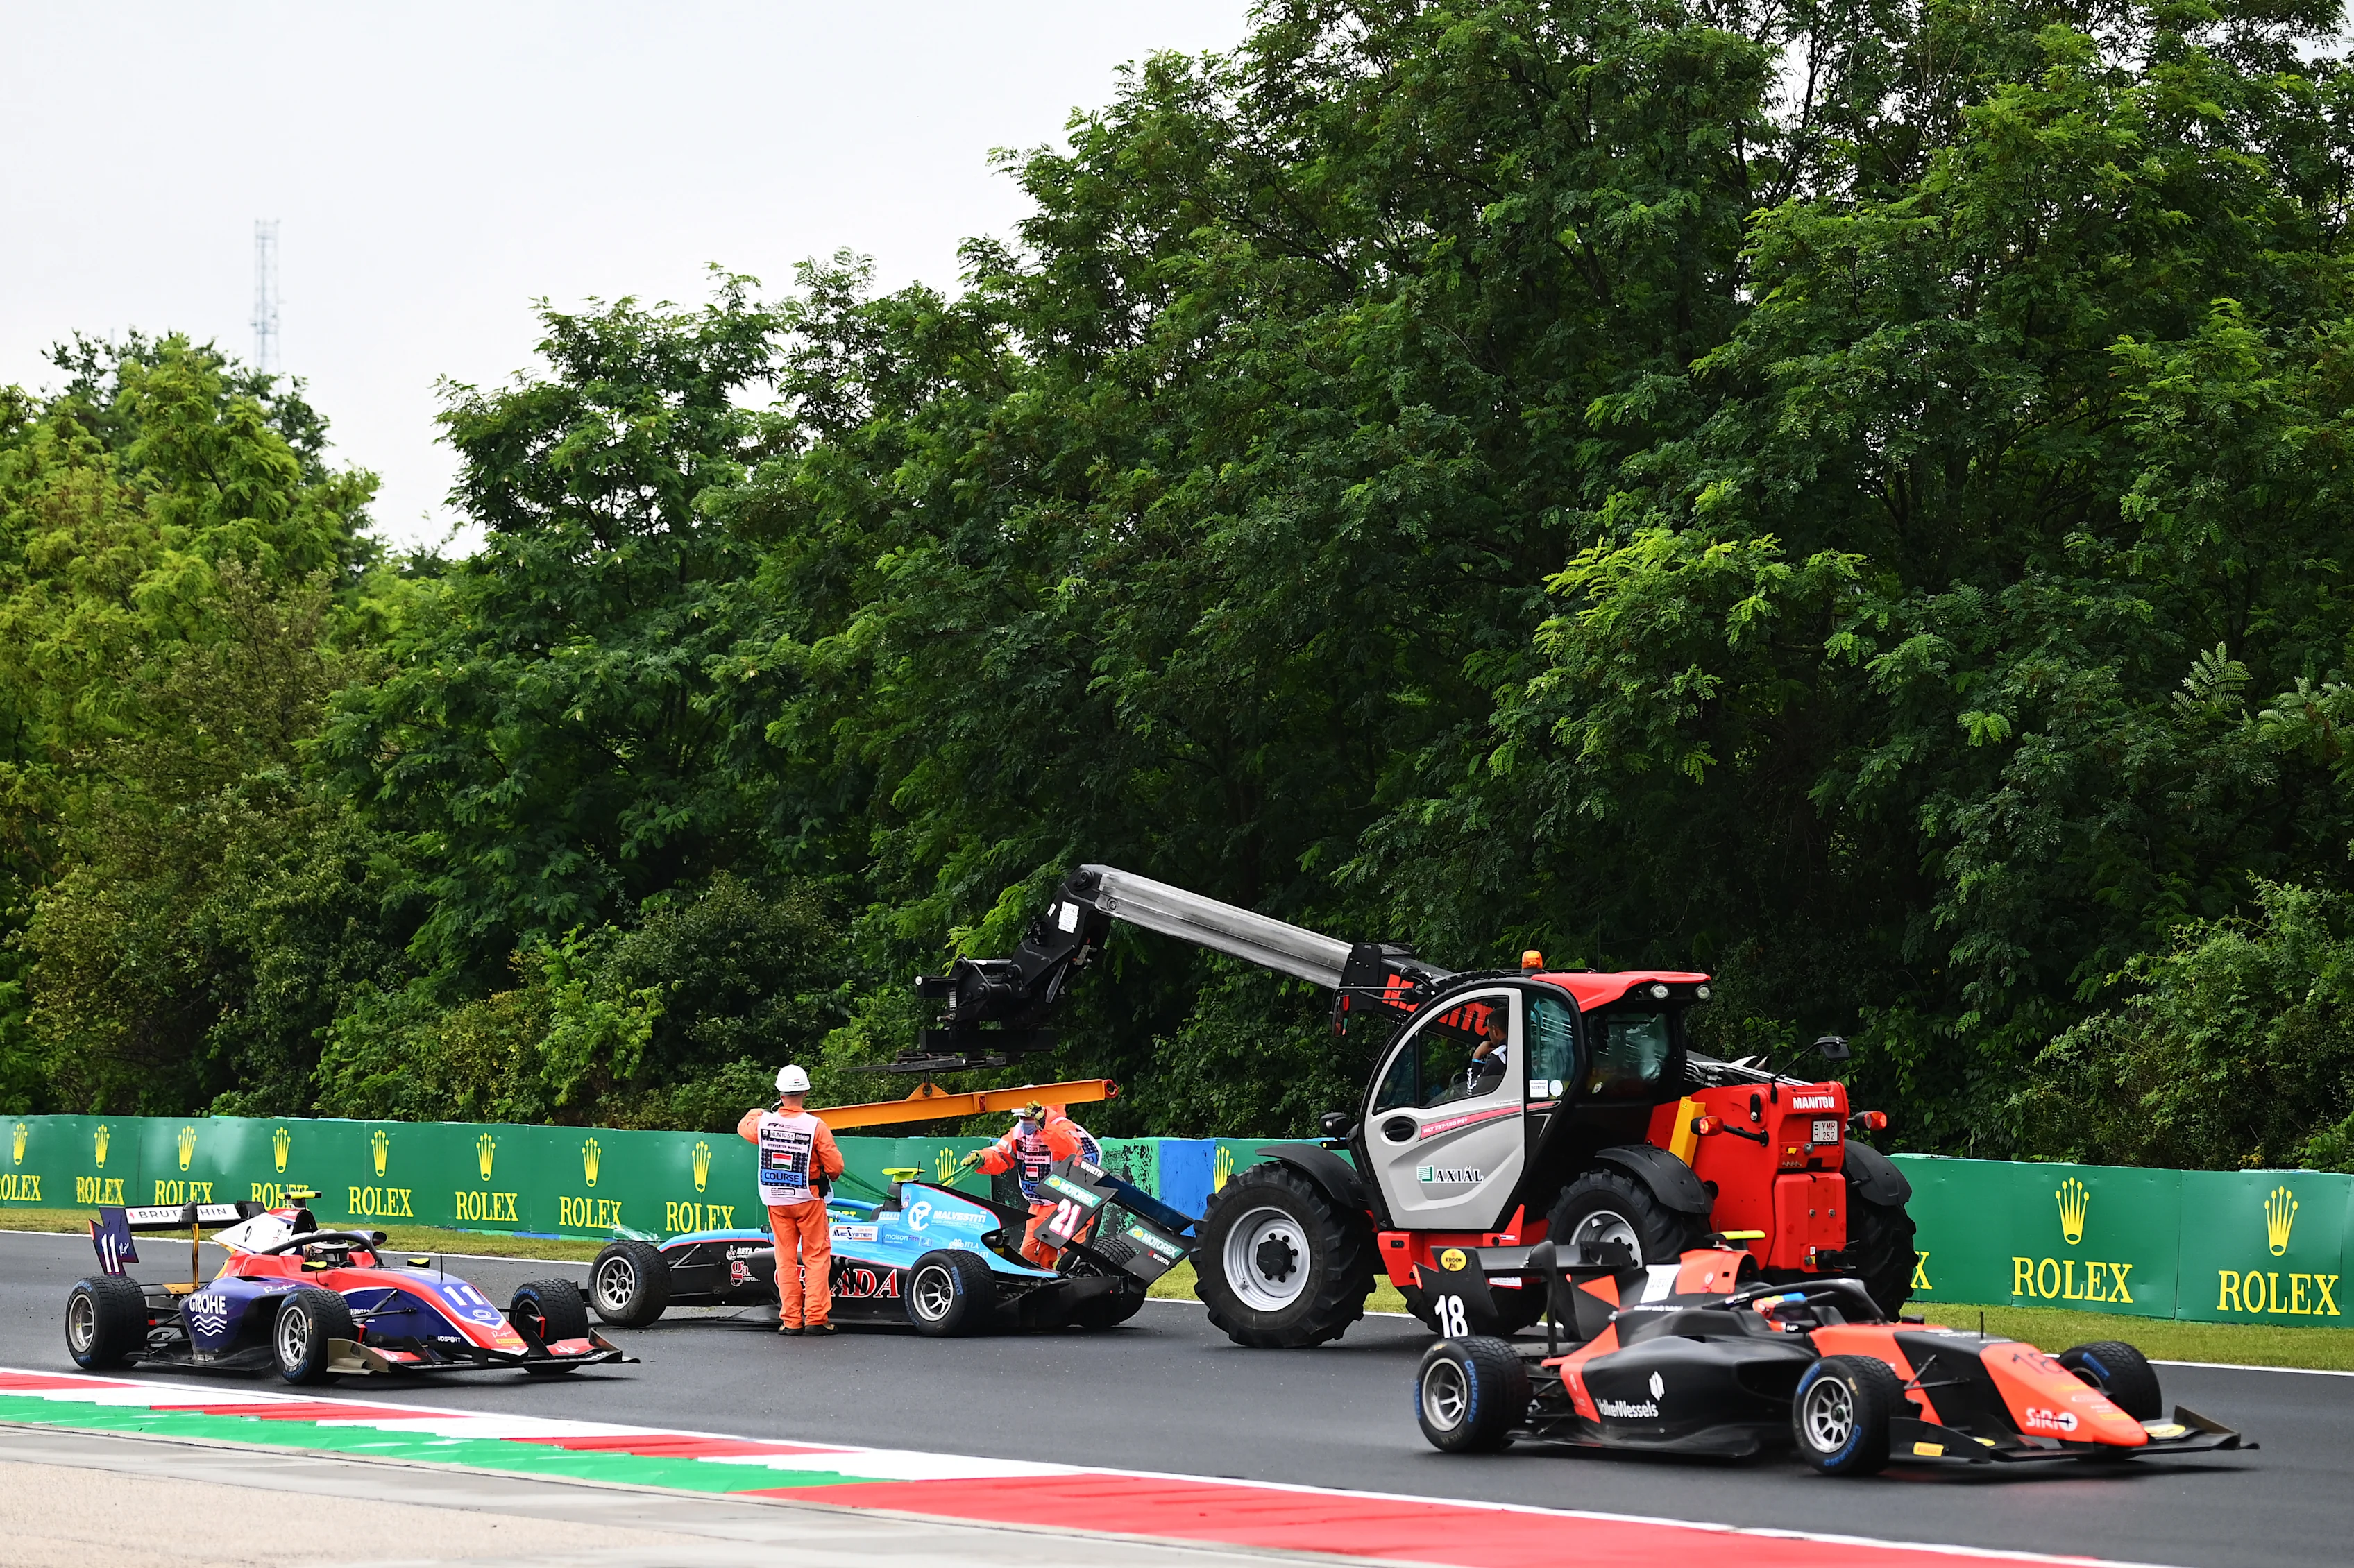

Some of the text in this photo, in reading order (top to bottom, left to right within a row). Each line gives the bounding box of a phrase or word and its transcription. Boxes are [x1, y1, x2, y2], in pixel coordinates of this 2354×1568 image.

[1793, 1096, 1834, 1109] MANITOU
[1822, 1122, 1836, 1131] YMR
[1822, 1132, 1835, 1140] 252
[0, 1174, 42, 1201] OLEX
[765, 1172, 799, 1183] COURSE
[1435, 1166, 1483, 1182] AXIÁL
[76, 1177, 125, 1205] ROLEX
[154, 1180, 214, 1206] ROLEX
[348, 1186, 414, 1218] ROLEX
[1059, 1182, 1097, 1208] MOTOREX
[139, 1207, 227, 1219] BRUTHIN
[455, 1191, 519, 1222] ROLEX
[559, 1196, 623, 1230] ROLEX
[665, 1201, 735, 1234] ROLEX
[1049, 1198, 1082, 1240] 21
[101, 1233, 119, 1274] 11
[1142, 1232, 1178, 1257] MOTOREX
[2012, 1257, 2133, 1304] ROLEX
[2217, 1270, 2341, 1316] ROLEX
[189, 1294, 228, 1315] GROHE
[443, 1286, 485, 1307] 11
[1434, 1294, 1468, 1339] 18
[1464, 1360, 1479, 1423] Cinturato
[1595, 1397, 1659, 1418] VolkerWessels
[1824, 1424, 1862, 1467] Cinturato
